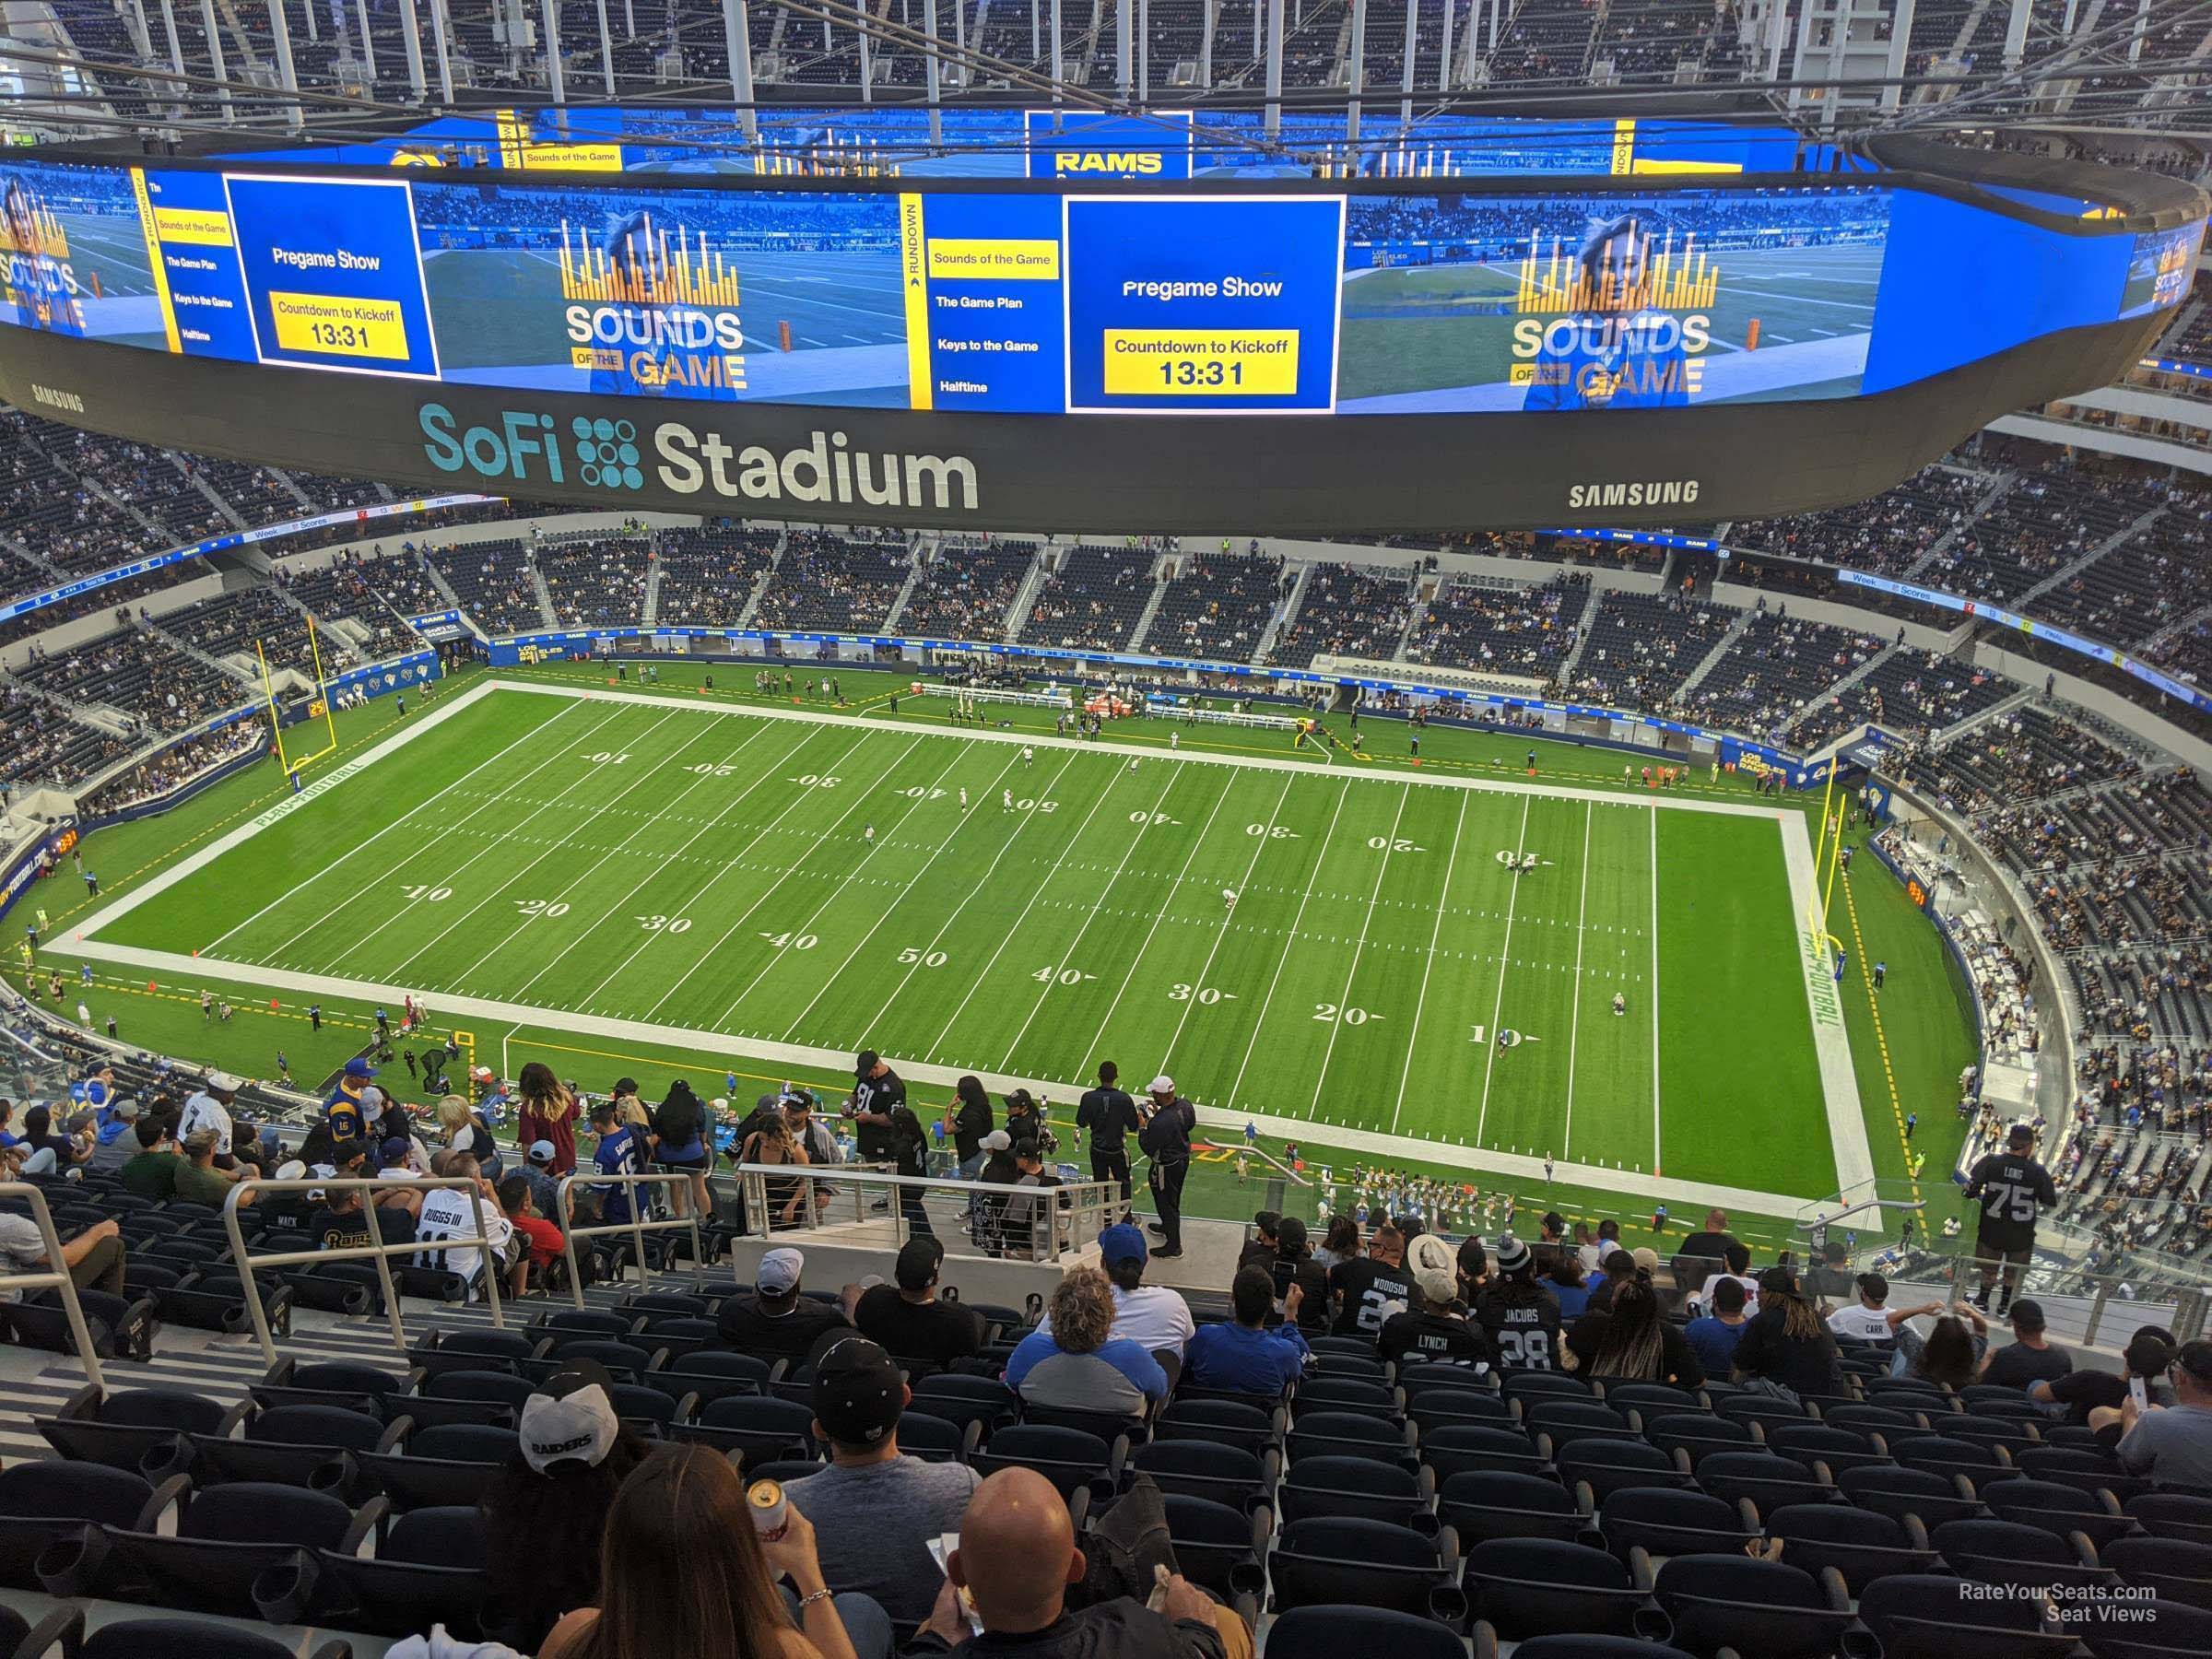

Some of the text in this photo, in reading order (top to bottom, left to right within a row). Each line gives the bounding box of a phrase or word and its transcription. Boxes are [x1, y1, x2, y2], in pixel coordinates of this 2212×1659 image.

[527, 152, 616, 162] Sounds of the Game
[1055, 153, 1162, 173] RAMS
[159, 219, 227, 234] Sounds of the Game
[907, 203, 918, 274] RUNDOWN
[167, 256, 217, 270] The Game Plan
[273, 247, 381, 271] Pregame Show
[934, 253, 1051, 266] Sounds of the Game
[1123, 276, 1283, 302] Pregame Show
[174, 292, 233, 309] Keys to the Game
[935, 296, 1023, 310] The Game Plan
[278, 300, 395, 323] Countdown to Kickoff
[182, 328, 211, 342] Halftime
[312, 323, 369, 348] 13:31
[566, 305, 745, 351] SOUNDS
[1512, 314, 1711, 358] SOUNDS
[937, 338, 1039, 354] Keys to the Game
[1113, 338, 1288, 356] Countdown to Kickoff
[576, 352, 618, 366] OF THE
[629, 351, 748, 390] GAME
[1159, 360, 1244, 386] 13:31
[1515, 370, 1535, 382] OF
[1575, 359, 1706, 398] GAME
[939, 380, 988, 394] Halftime
[32, 382, 85, 414] SAMSUNG
[418, 402, 980, 510] SoFi Stadium
[1568, 478, 1700, 511] SAMSUNG
[254, 517, 328, 540] Week Scores
[1853, 572, 1932, 602] Week Scores
[421, 614, 446, 625] RAMS
[310, 703, 324, 715] 25
[593, 751, 633, 764] 10
[1740, 750, 1762, 762] LOS
[692, 762, 738, 776] 20
[299, 762, 365, 804] FOOTBALL
[799, 774, 842, 788] 30
[902, 786, 948, 800] 40
[1017, 797, 1059, 813] 50
[1129, 810, 1173, 826] 40
[1246, 823, 1292, 840] 30
[1367, 836, 1415, 853] 20
[403, 885, 453, 901] 10
[517, 899, 571, 918] 20
[641, 914, 692, 935] 30
[767, 931, 819, 950] 40
[897, 947, 947, 967] 50
[1031, 966, 1083, 986] 40
[1168, 982, 1222, 1006] 30
[1312, 1002, 1369, 1027] 20
[1467, 1025, 1521, 1047] 10
[857, 1082, 876, 1114] 81
[1985, 1181, 2037, 1222] 75
[277, 1215, 298, 1228] MACK
[423, 1207, 464, 1227] RUGGS III
[420, 1230, 450, 1271] 11
[1372, 1277, 1409, 1296] WOODSON
[1503, 1307, 1539, 1324] JACOBS
[1865, 1323, 1885, 1335] CARR
[1418, 1333, 1449, 1351] LYNCH
[1498, 1330, 1552, 1371] 28
[531, 1432, 593, 1454] RAIDERS
